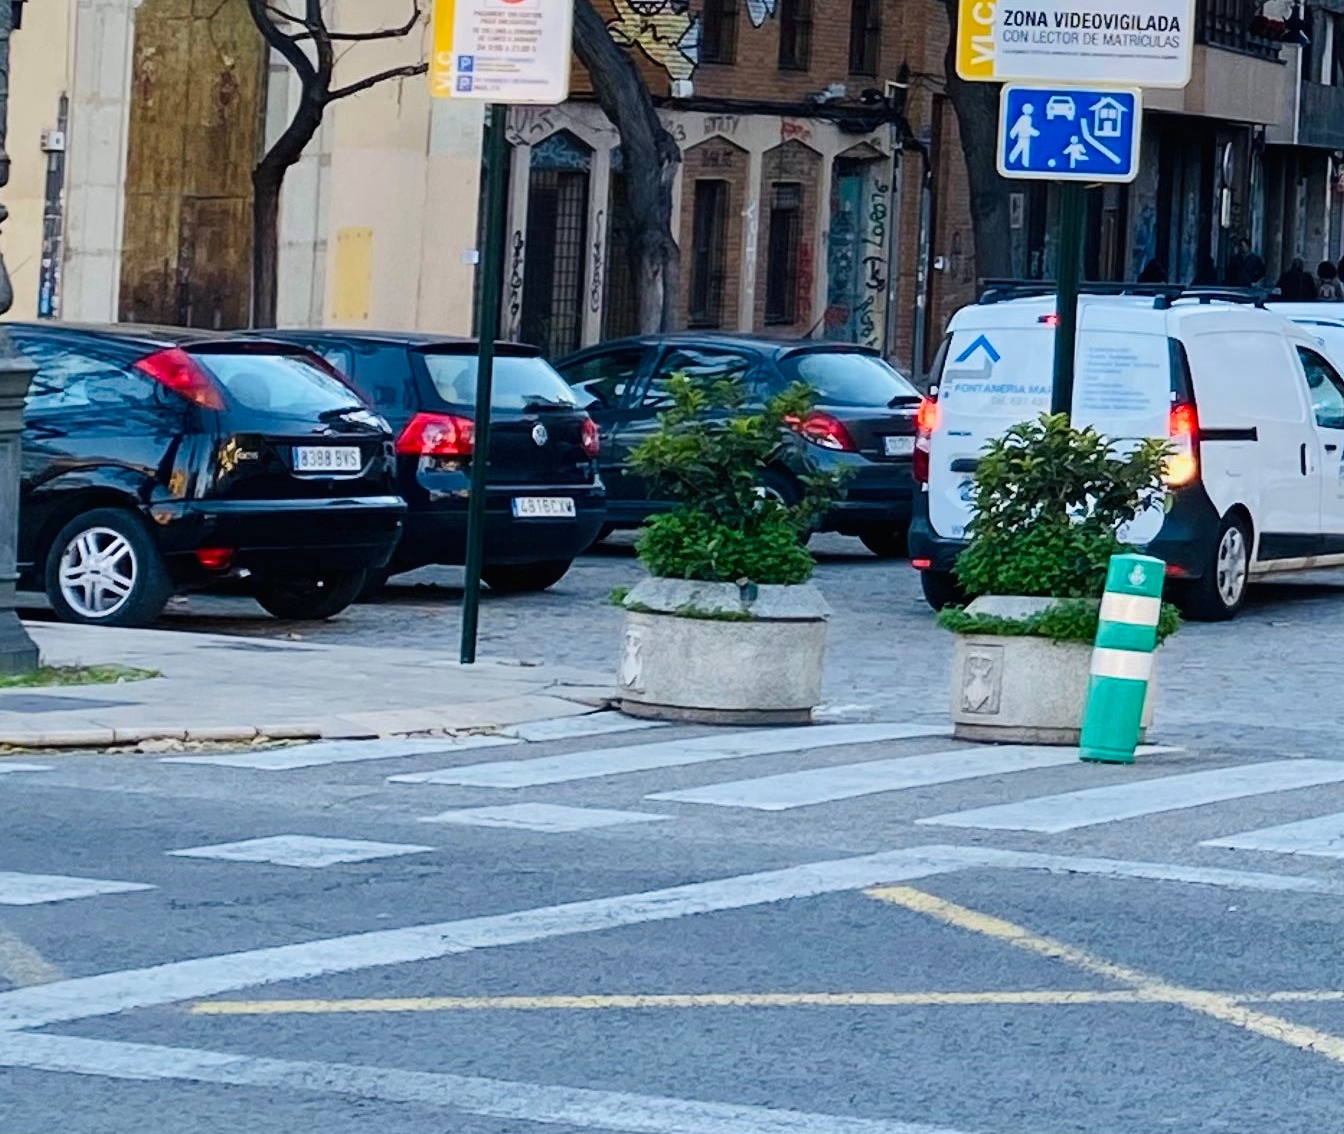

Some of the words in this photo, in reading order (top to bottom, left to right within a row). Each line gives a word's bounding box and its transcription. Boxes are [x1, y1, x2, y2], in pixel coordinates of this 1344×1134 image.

[1003, 10, 1048, 27] ZONA
[1054, 12, 1180, 32] VIDEOVIGILADA
[970, 1, 996, 65] VLC
[1003, 29, 1028, 43] CON
[1032, 31, 1079, 44] LECTOR
[1083, 32, 1099, 46] DE
[1103, 33, 1180, 48] MATRÍCULAS
[954, 383, 1026, 394] FONTANERIA
